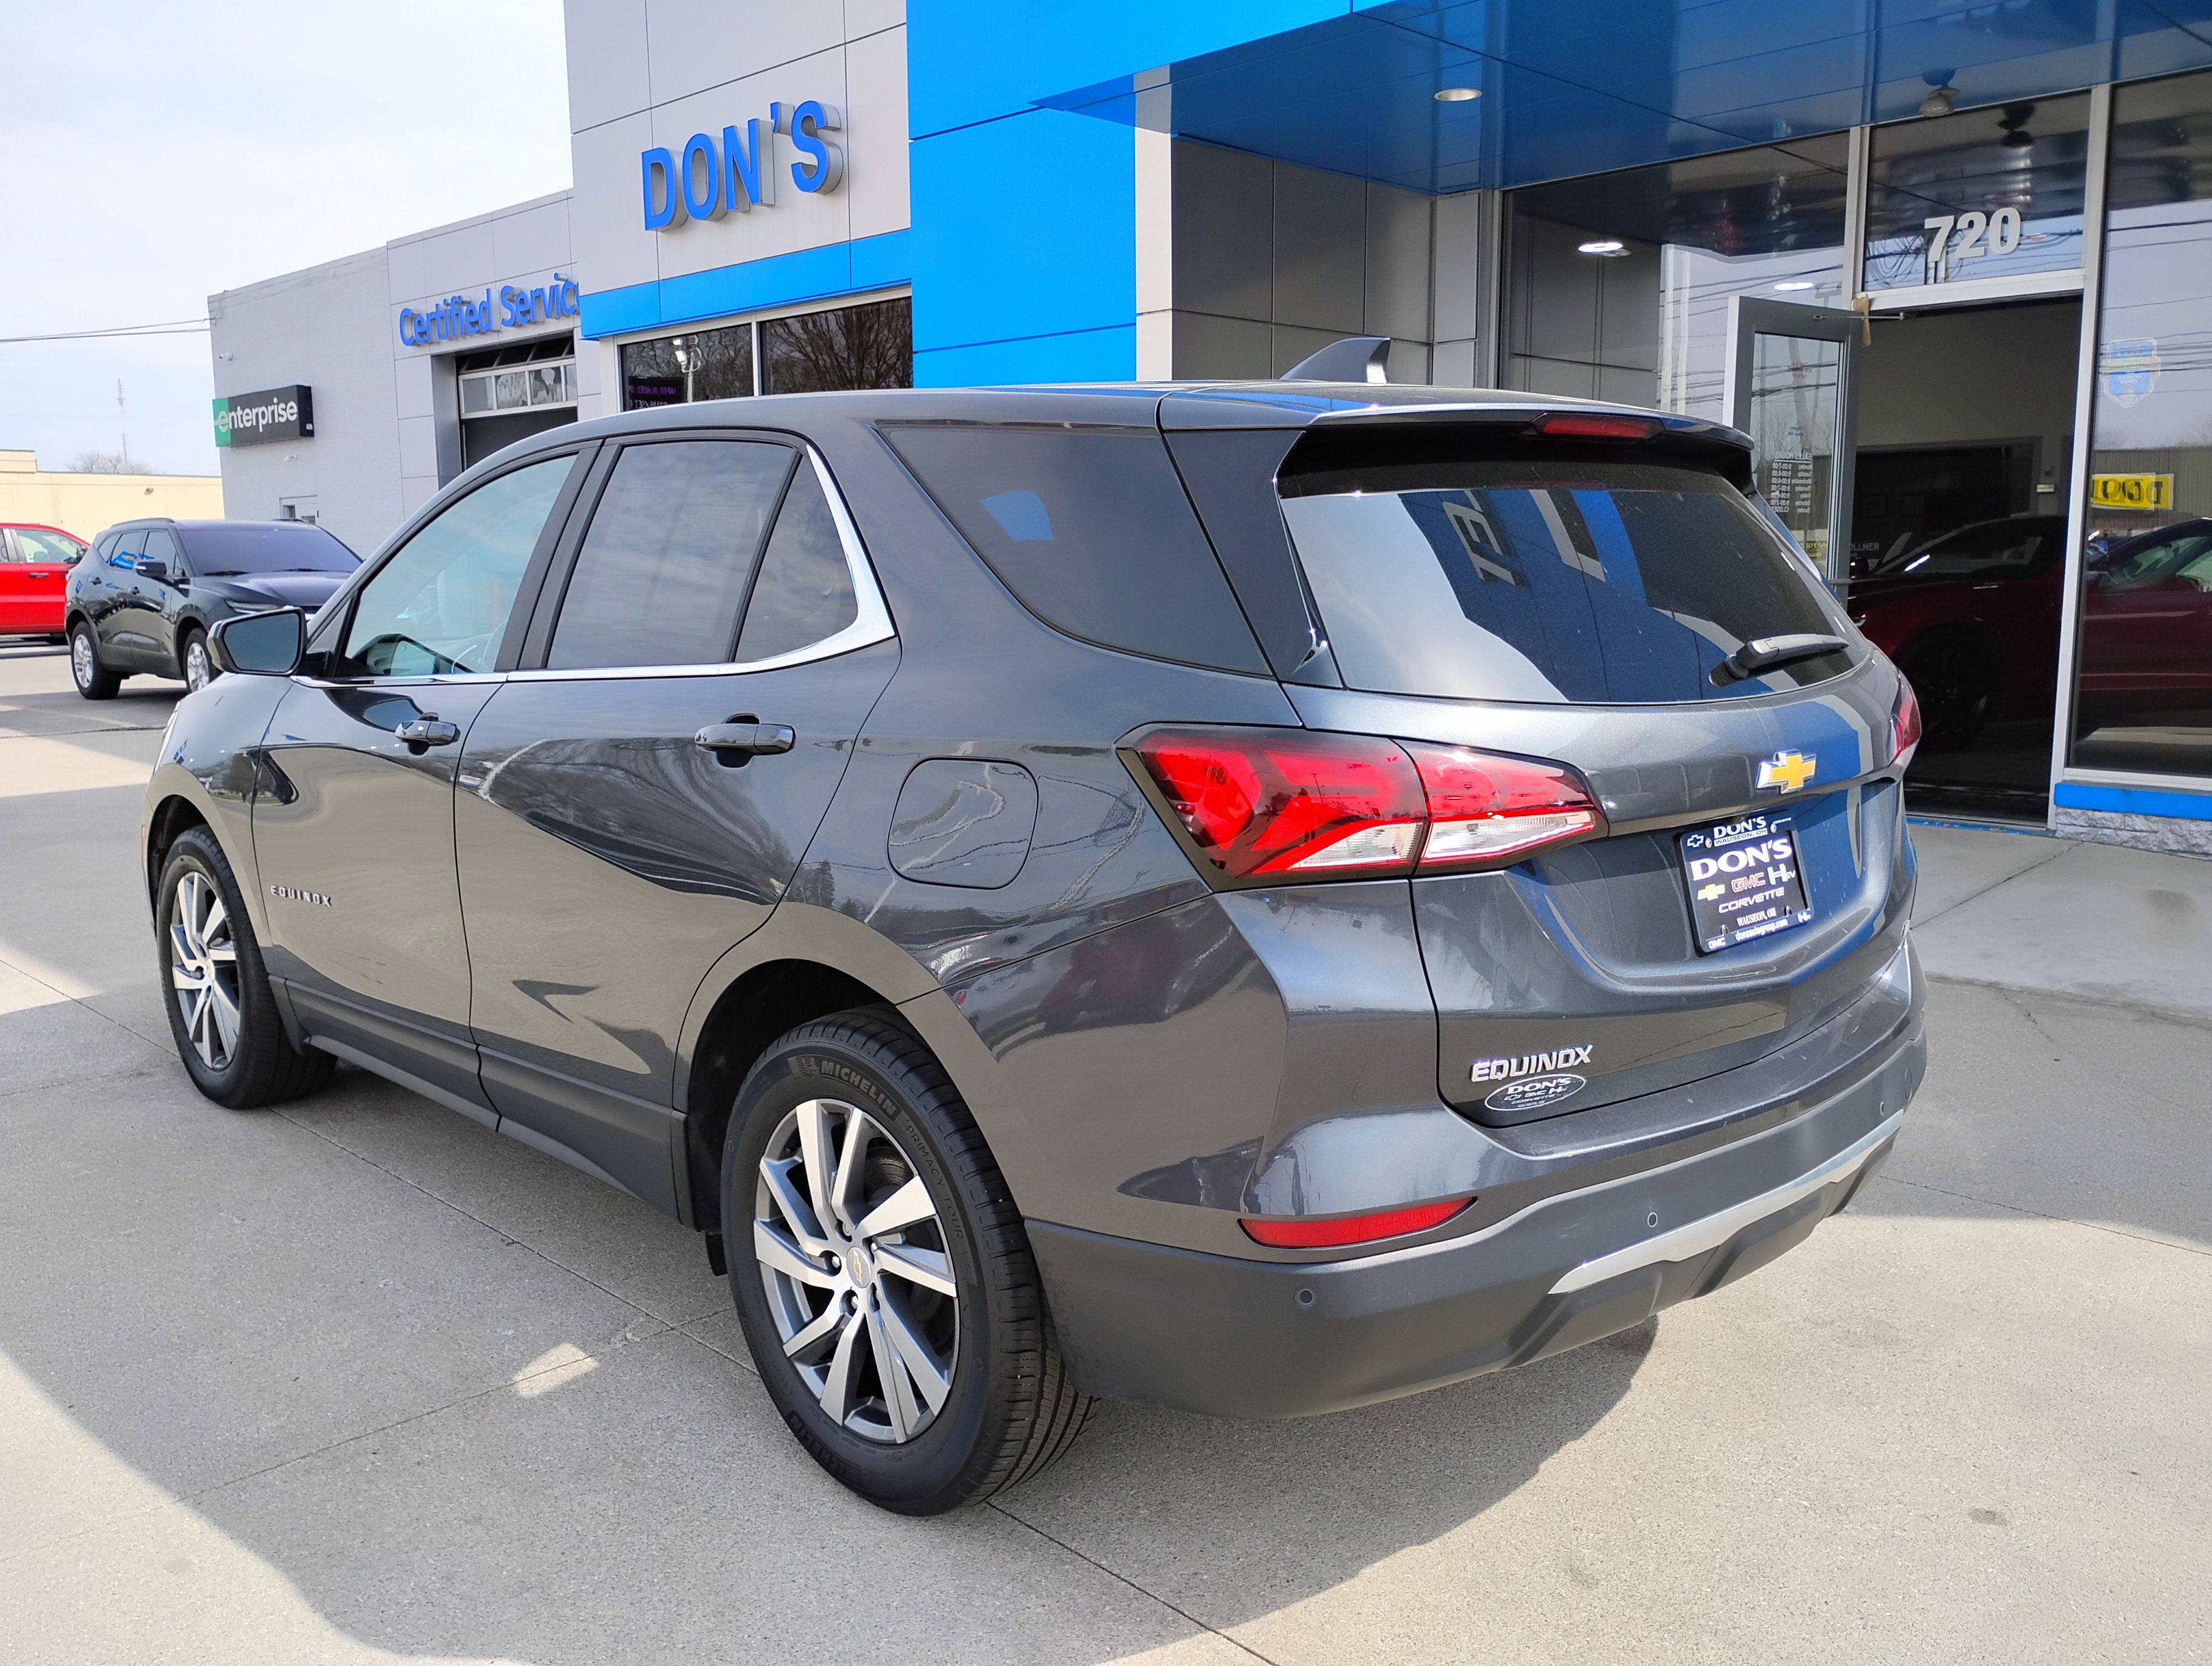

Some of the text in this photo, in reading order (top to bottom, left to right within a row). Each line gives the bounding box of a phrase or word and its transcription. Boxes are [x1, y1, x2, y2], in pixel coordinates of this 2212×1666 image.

[641, 100, 842, 231] DON'S
[1924, 208, 2021, 262] 720
[400, 288, 492, 347] Certified
[215, 396, 298, 433] enterprise
[1713, 816, 1766, 839] DON'S
[1715, 832, 1754, 845] WAUSEON,
[1689, 838, 1792, 881] DON'S
[271, 885, 332, 908] EQUINOX
[1731, 872, 1766, 893] GMC
[1718, 887, 1785, 913] CORVETTE
[1708, 937, 1726, 950] GMC
[1470, 1045, 1593, 1082] EQUINOX
[821, 1060, 897, 1116] MICHELIN
[1506, 1078, 1571, 1094] DON'S
[1525, 1090, 1547, 1098] GMC
[906, 1125, 963, 1239] PRIMACY TOUR
